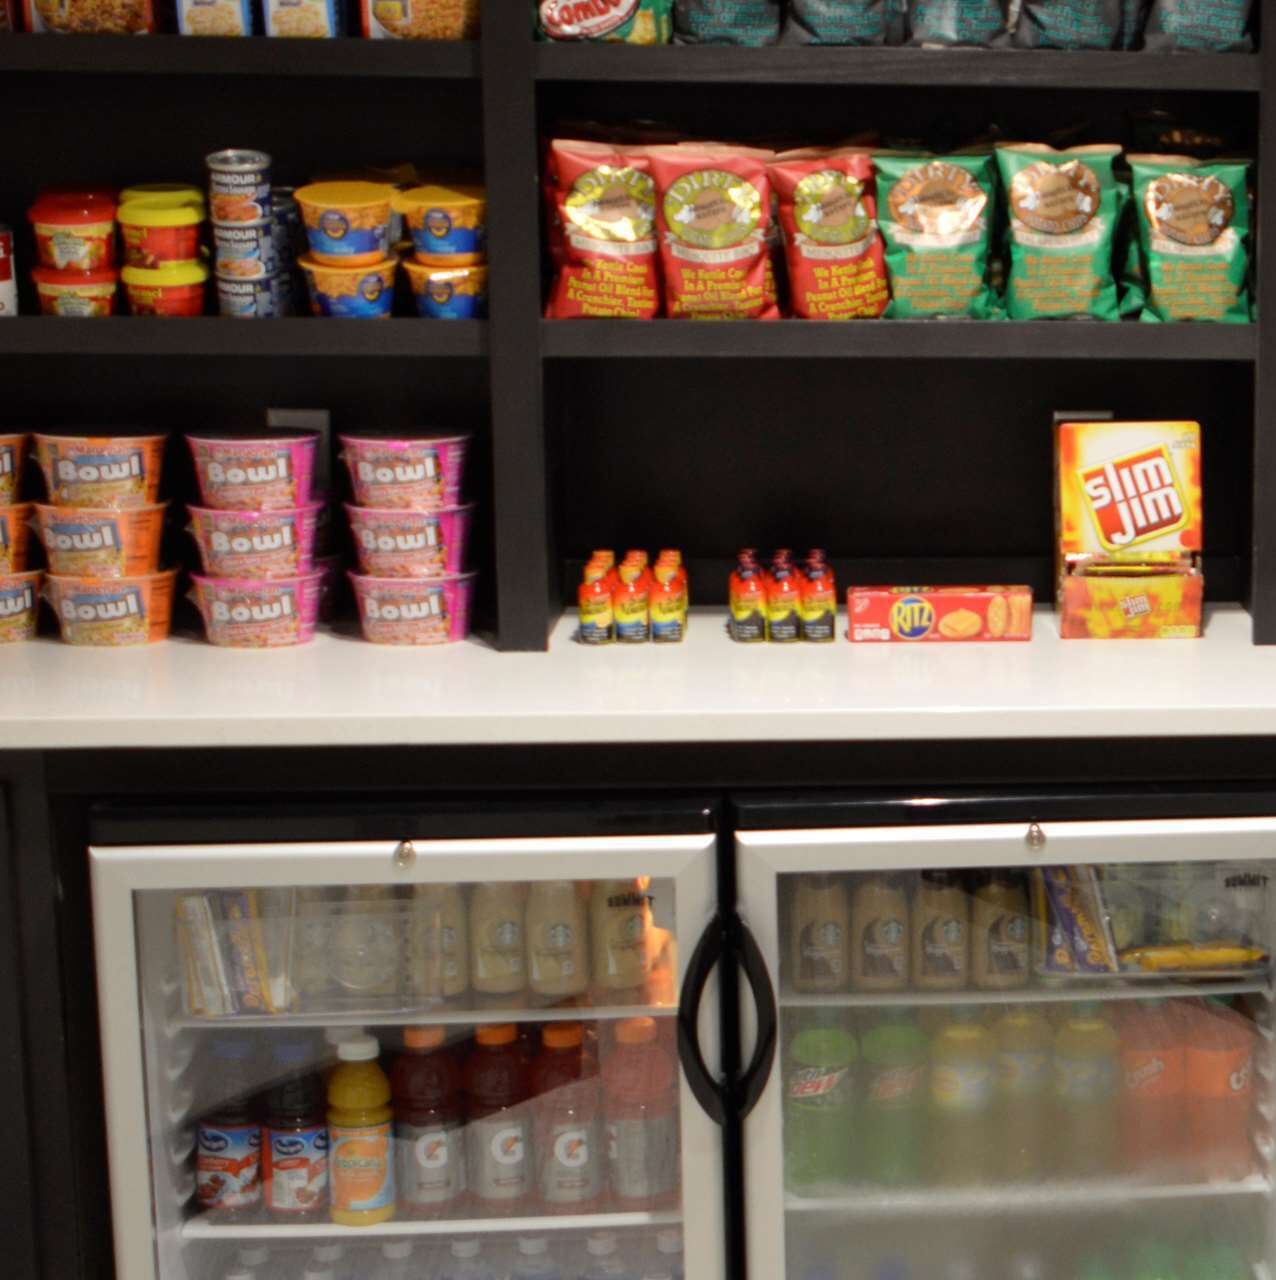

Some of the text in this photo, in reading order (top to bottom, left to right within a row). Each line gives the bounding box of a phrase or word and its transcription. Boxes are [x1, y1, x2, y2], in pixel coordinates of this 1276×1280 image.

[58, 454, 141, 481] Bowl
[207, 458, 287, 483] Bowl
[357, 457, 435, 483] Bowl
[1084, 455, 1174, 510] slim
[1110, 485, 1183, 545] Jim
[211, 527, 292, 552] Bowl
[360, 526, 437, 550] Bowl
[61, 592, 138, 619] Bowl
[211, 595, 292, 621] Bowl
[365, 596, 440, 621] Bowl
[894, 602, 932, 634] RITZ
